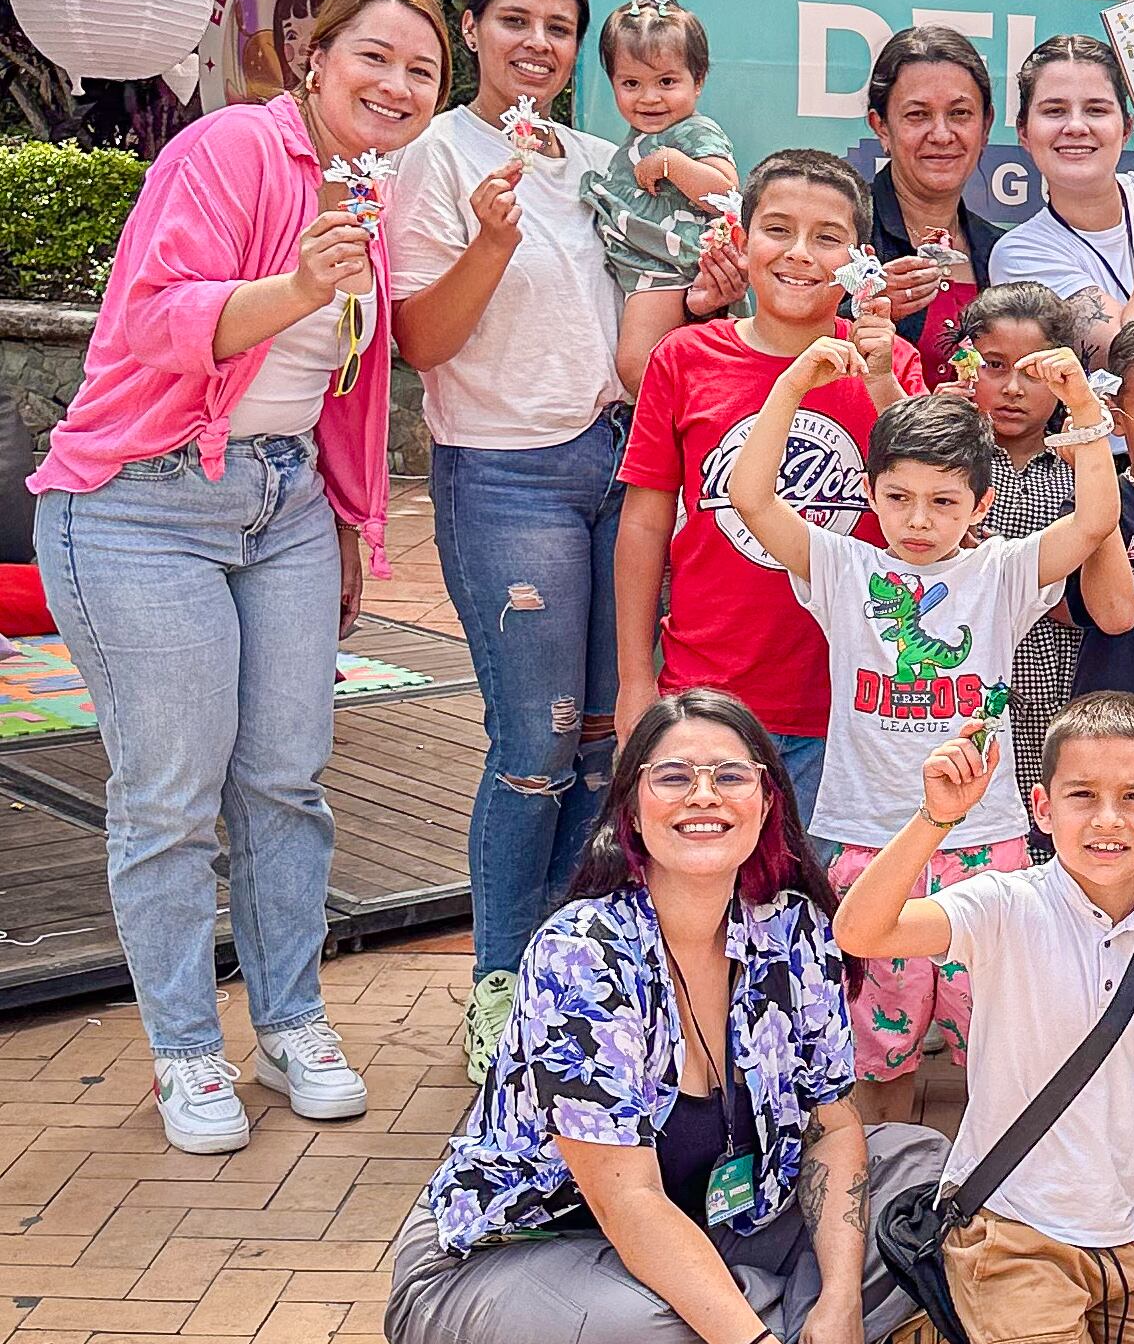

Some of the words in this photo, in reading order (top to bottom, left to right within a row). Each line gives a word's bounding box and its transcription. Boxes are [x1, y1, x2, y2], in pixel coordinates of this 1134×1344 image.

[794, 418, 841, 445] STATES
[806, 510, 825, 522] CITY
[737, 529, 753, 545] OF
[880, 719, 949, 733] LEAGUE
